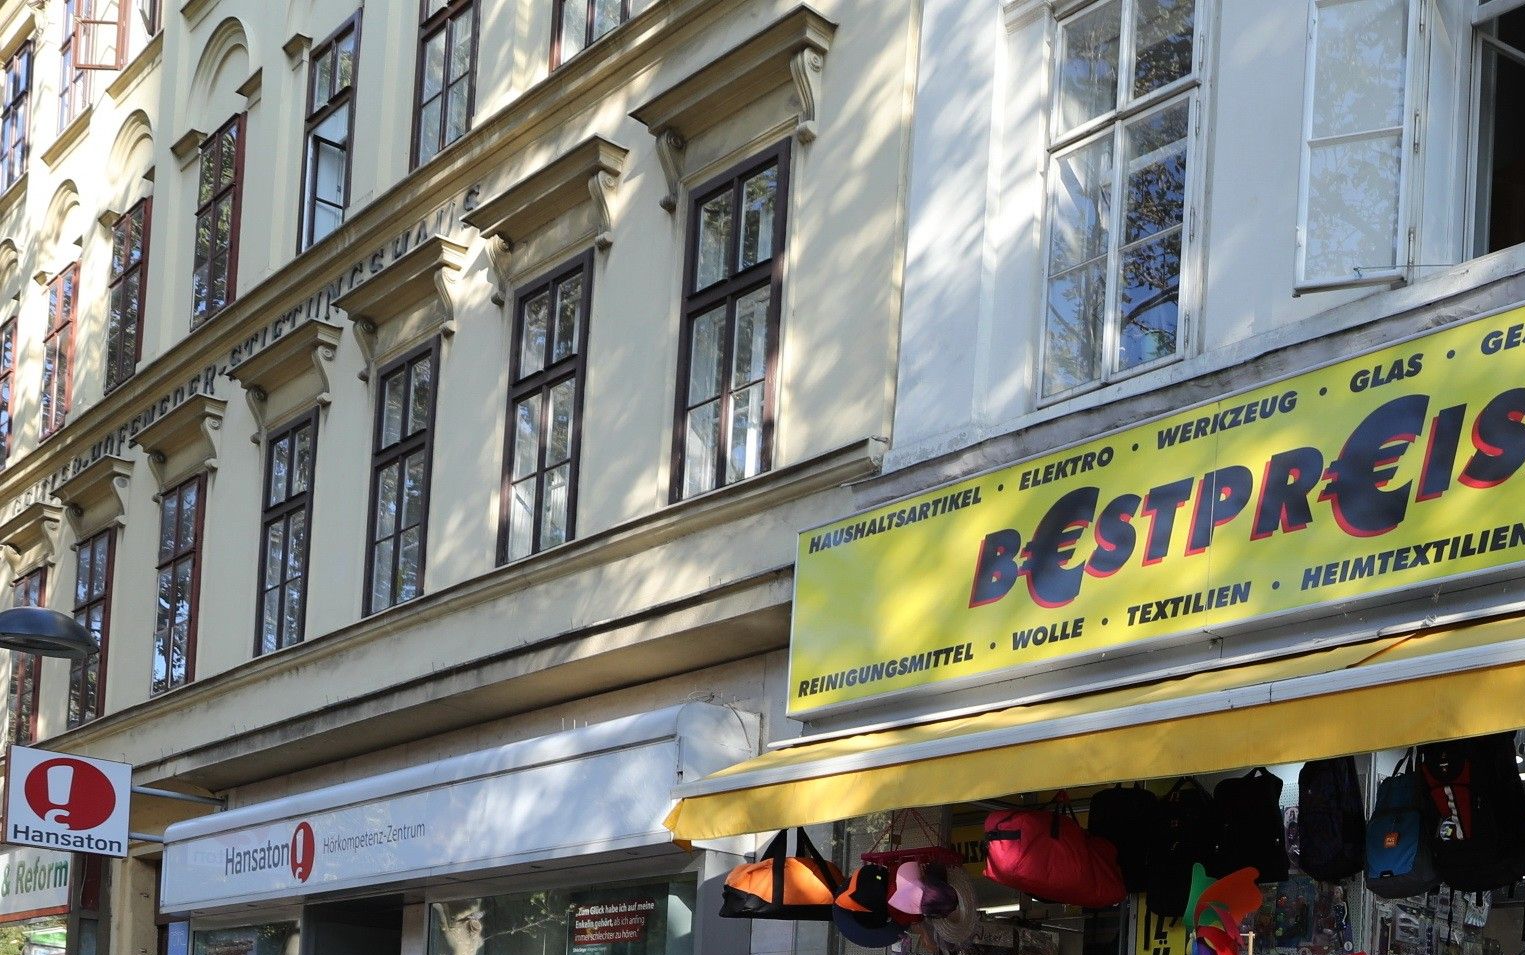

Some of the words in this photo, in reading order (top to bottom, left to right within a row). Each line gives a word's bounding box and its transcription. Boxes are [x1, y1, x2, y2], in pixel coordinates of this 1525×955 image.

[809, 486, 982, 554] HAUSHALTSARTIKEL
[1019, 446, 1114, 491] ELEKTRO
[1157, 391, 1298, 449] WERKZEUG
[1349, 353, 1423, 393] GLAS
[798, 642, 974, 698] REINIGUNGSMITTEL
[1012, 616, 1084, 650] WOLLE
[1126, 580, 1251, 627] TEXTILIEN
[13, 822, 123, 853] Hansaton
[225, 840, 290, 876] Hansaton
[322, 821, 426, 855] Hörkompetenz-Zentrum
[1, 863, 11, 898] &
[15, 854, 69, 895] Reform
